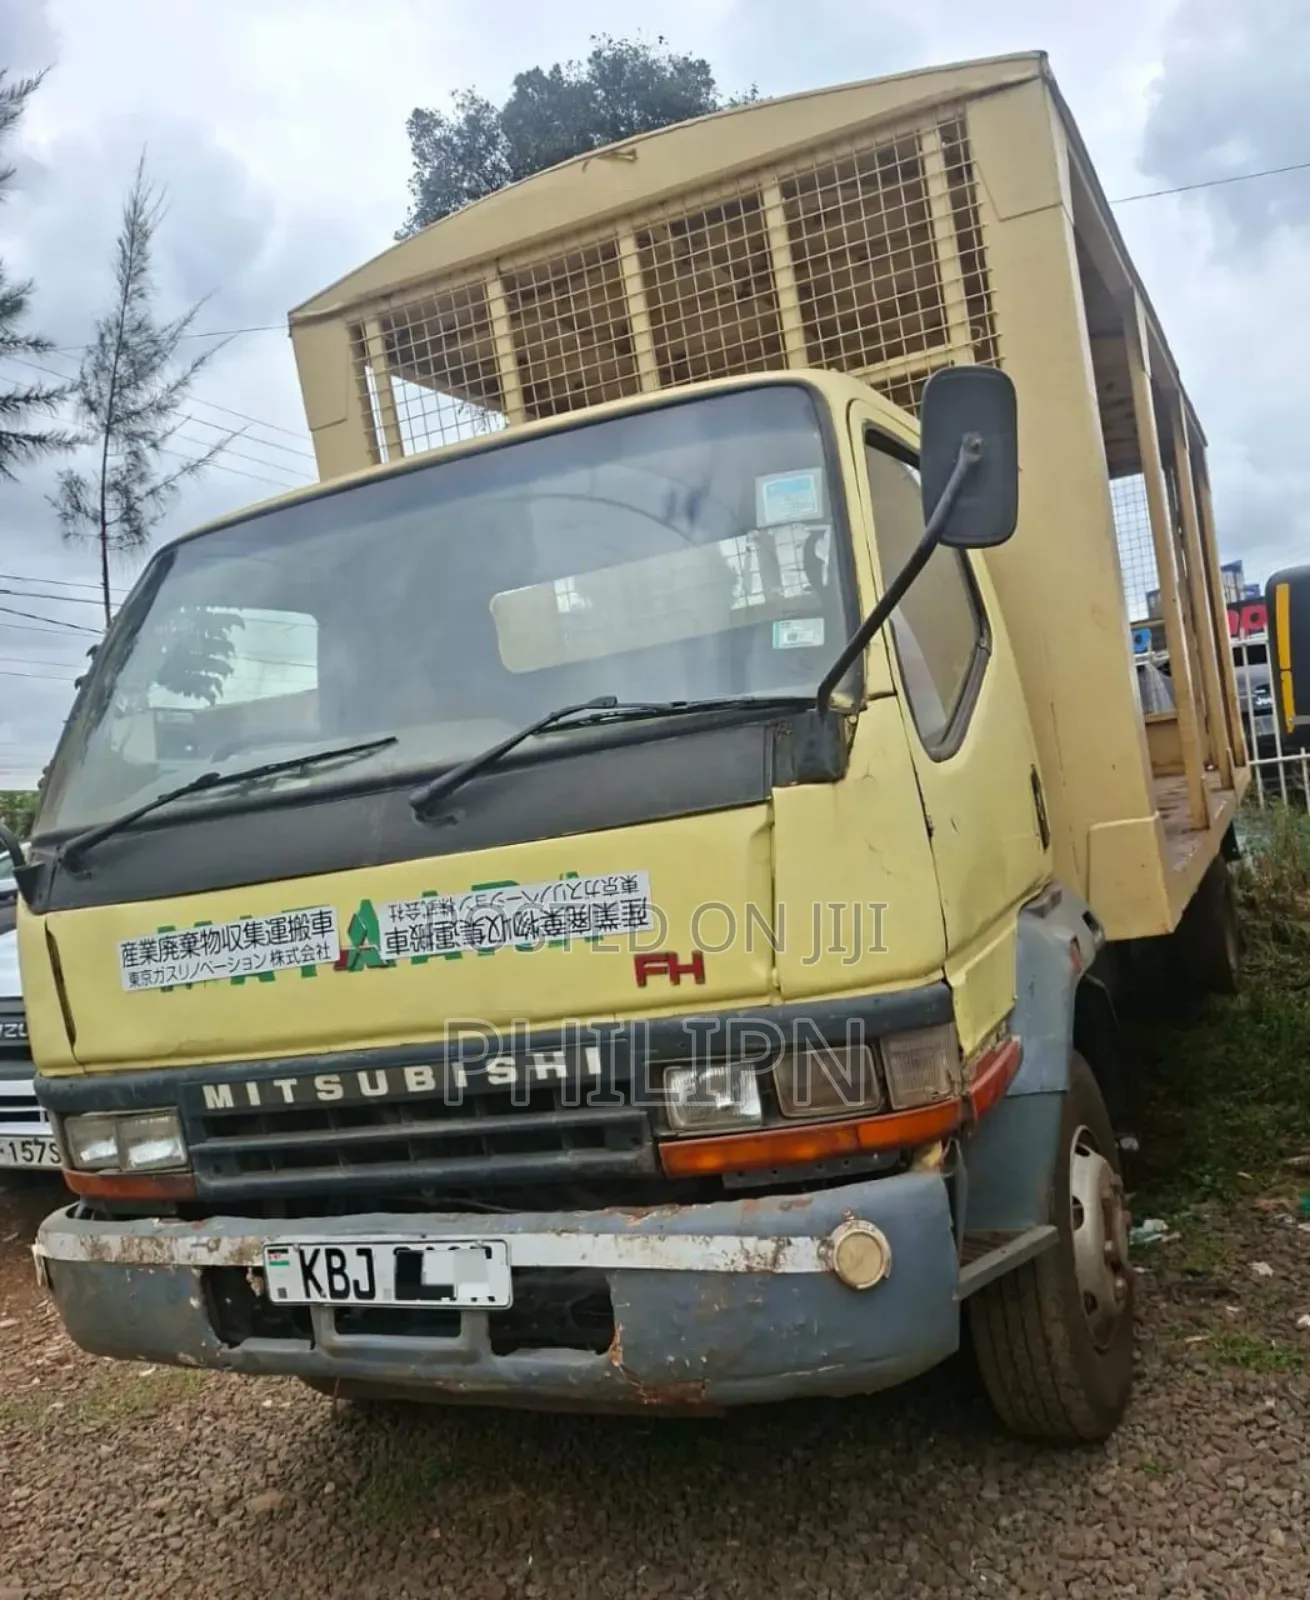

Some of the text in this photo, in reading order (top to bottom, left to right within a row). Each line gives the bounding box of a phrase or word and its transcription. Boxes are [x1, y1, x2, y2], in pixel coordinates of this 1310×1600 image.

[120, 909, 335, 968] 産業廃棄物収集運搬車
[385, 897, 651, 955] 産業廃棄物収集運搬車
[633, 949, 707, 988] FH
[202, 1046, 602, 1110] MITSUBISHI
[299, 1247, 376, 1301] KBJ
